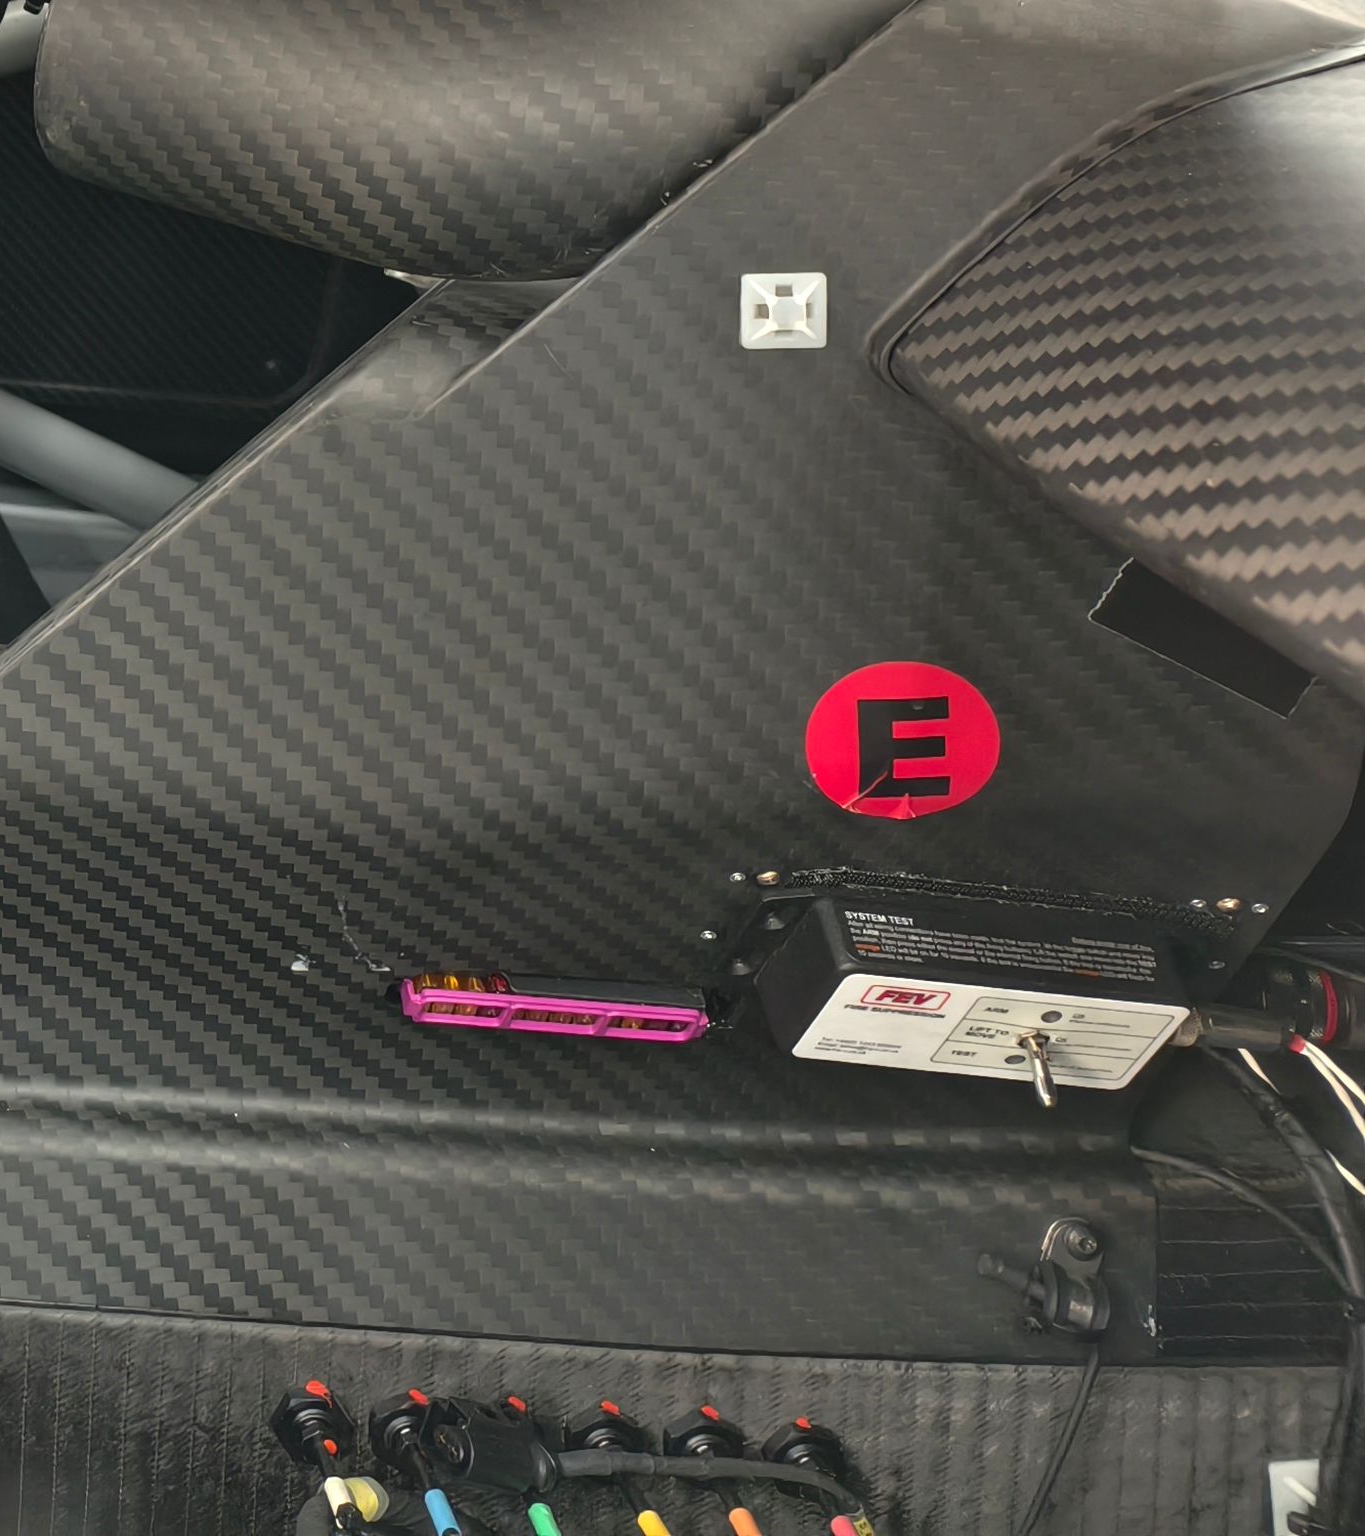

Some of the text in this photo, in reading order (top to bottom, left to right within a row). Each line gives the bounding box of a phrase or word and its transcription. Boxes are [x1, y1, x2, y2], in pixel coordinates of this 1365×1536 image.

[857, 696, 951, 798] E
[845, 911, 914, 926] SYSTEM TEST
[875, 989, 938, 1005] FEV
